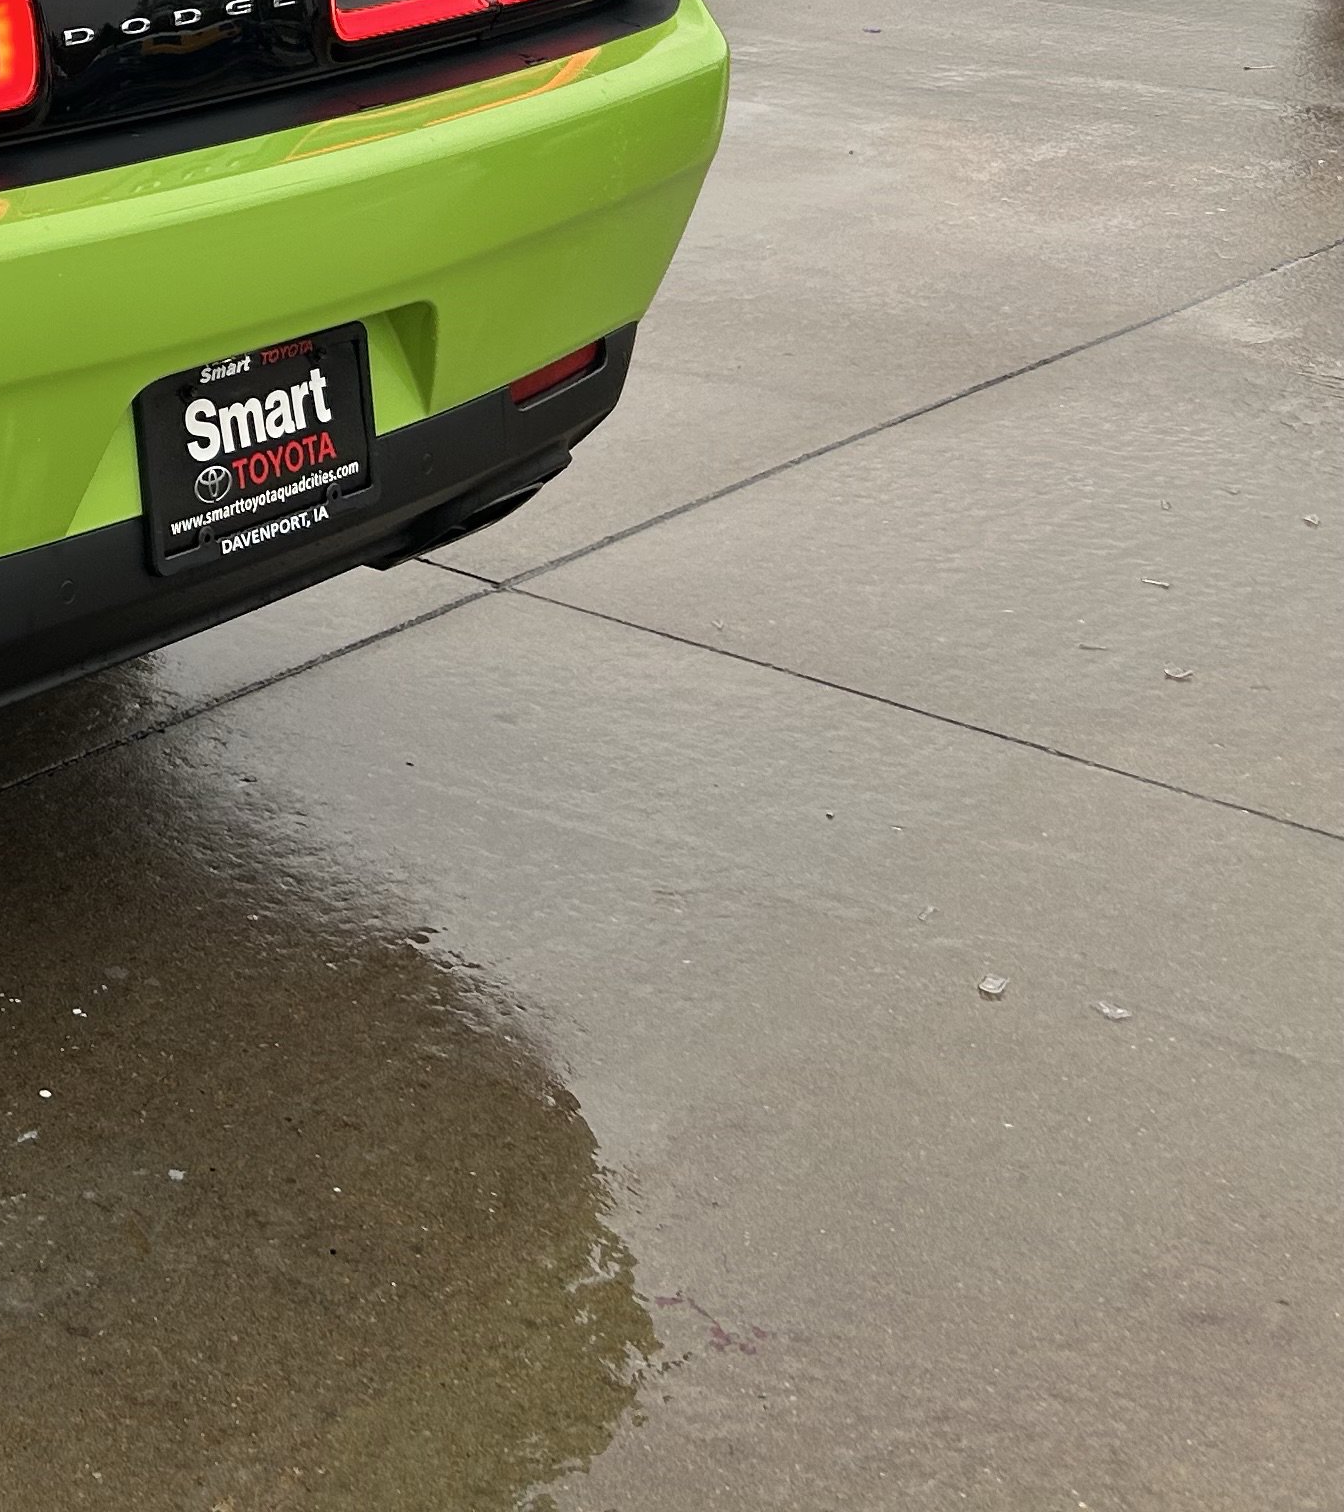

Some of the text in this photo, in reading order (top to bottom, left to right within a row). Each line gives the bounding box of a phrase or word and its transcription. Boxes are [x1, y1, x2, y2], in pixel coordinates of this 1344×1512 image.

[199, 340, 314, 384] Smart TOYOTA
[185, 368, 332, 462] Smart
[232, 431, 338, 490] TOYOTA
[170, 461, 360, 536] www.smarttoyotaquadcities.com
[221, 505, 330, 555] DAVENPORT, IA
